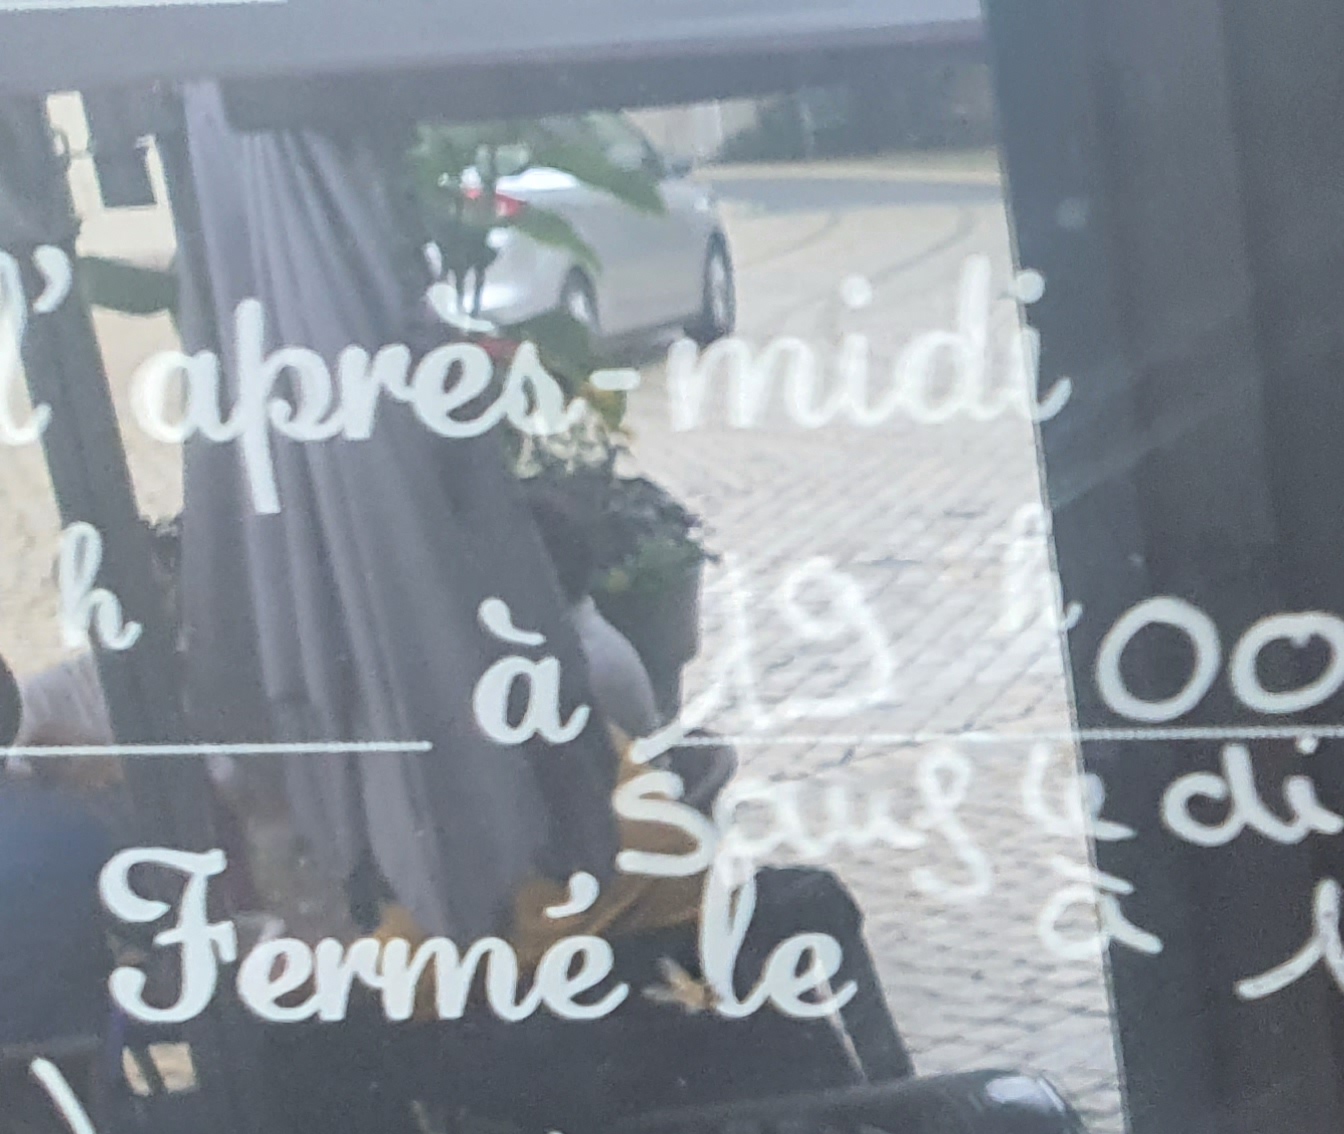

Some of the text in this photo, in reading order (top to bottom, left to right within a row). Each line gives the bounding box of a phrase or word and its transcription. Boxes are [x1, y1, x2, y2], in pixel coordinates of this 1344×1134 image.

[57, 521, 142, 650] h
[472, 597, 589, 745] à
[98, 847, 859, 1024] Fermé le
